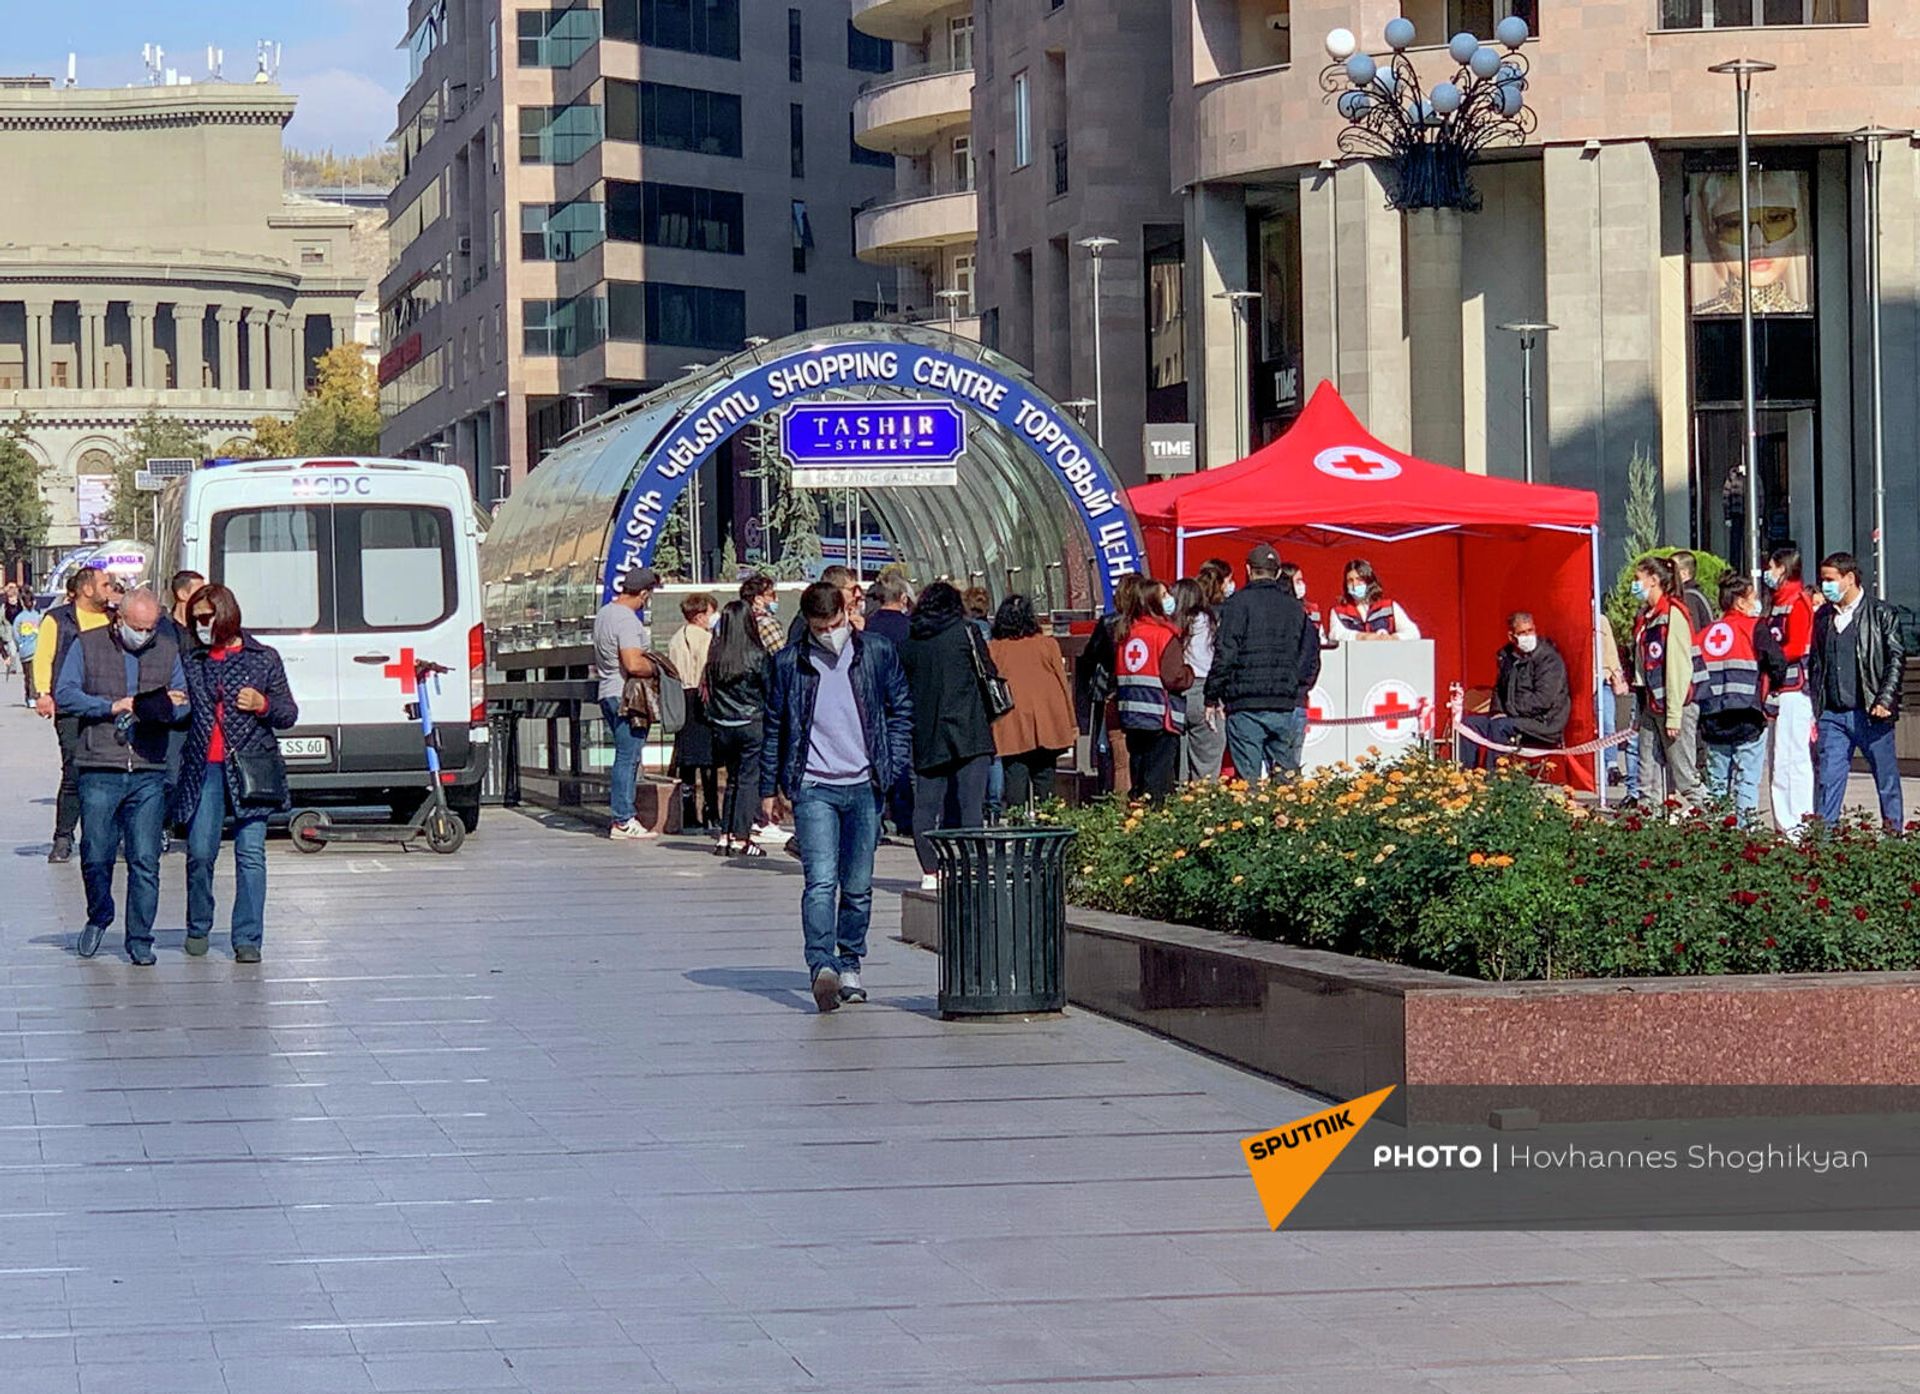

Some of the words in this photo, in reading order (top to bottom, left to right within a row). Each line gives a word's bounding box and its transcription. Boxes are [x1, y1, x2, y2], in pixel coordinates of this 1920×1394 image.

[767, 351, 899, 398] SHOPPING
[913, 356, 1009, 412] CENTRE
[1274, 367, 1297, 402] TIME
[812, 415, 934, 437] TASHIR
[835, 438, 912, 451] STREET
[1150, 440, 1192, 456] TIME
[1014, 399, 1121, 518] ТОРГОВЫЙ
[292, 476, 371, 497] NCDC
[286, 740, 304, 754] SS
[307, 740, 322, 753] 60
